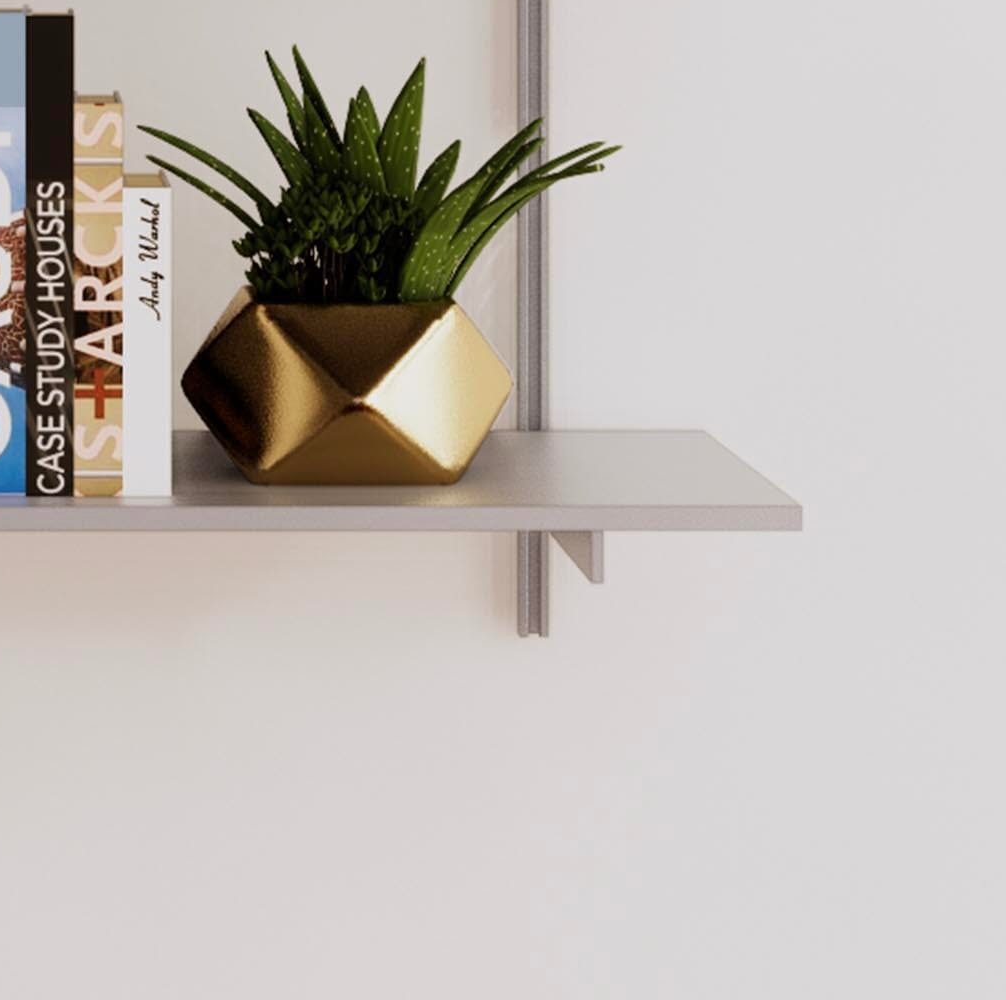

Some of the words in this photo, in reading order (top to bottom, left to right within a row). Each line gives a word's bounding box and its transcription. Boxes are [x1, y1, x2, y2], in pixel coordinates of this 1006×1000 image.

[36, 182, 65, 301] HOUSES
[138, 197, 161, 262] Warhol
[138, 271, 165, 321] Andy
[36, 310, 65, 406] STUDY
[36, 415, 65, 494] CASE
